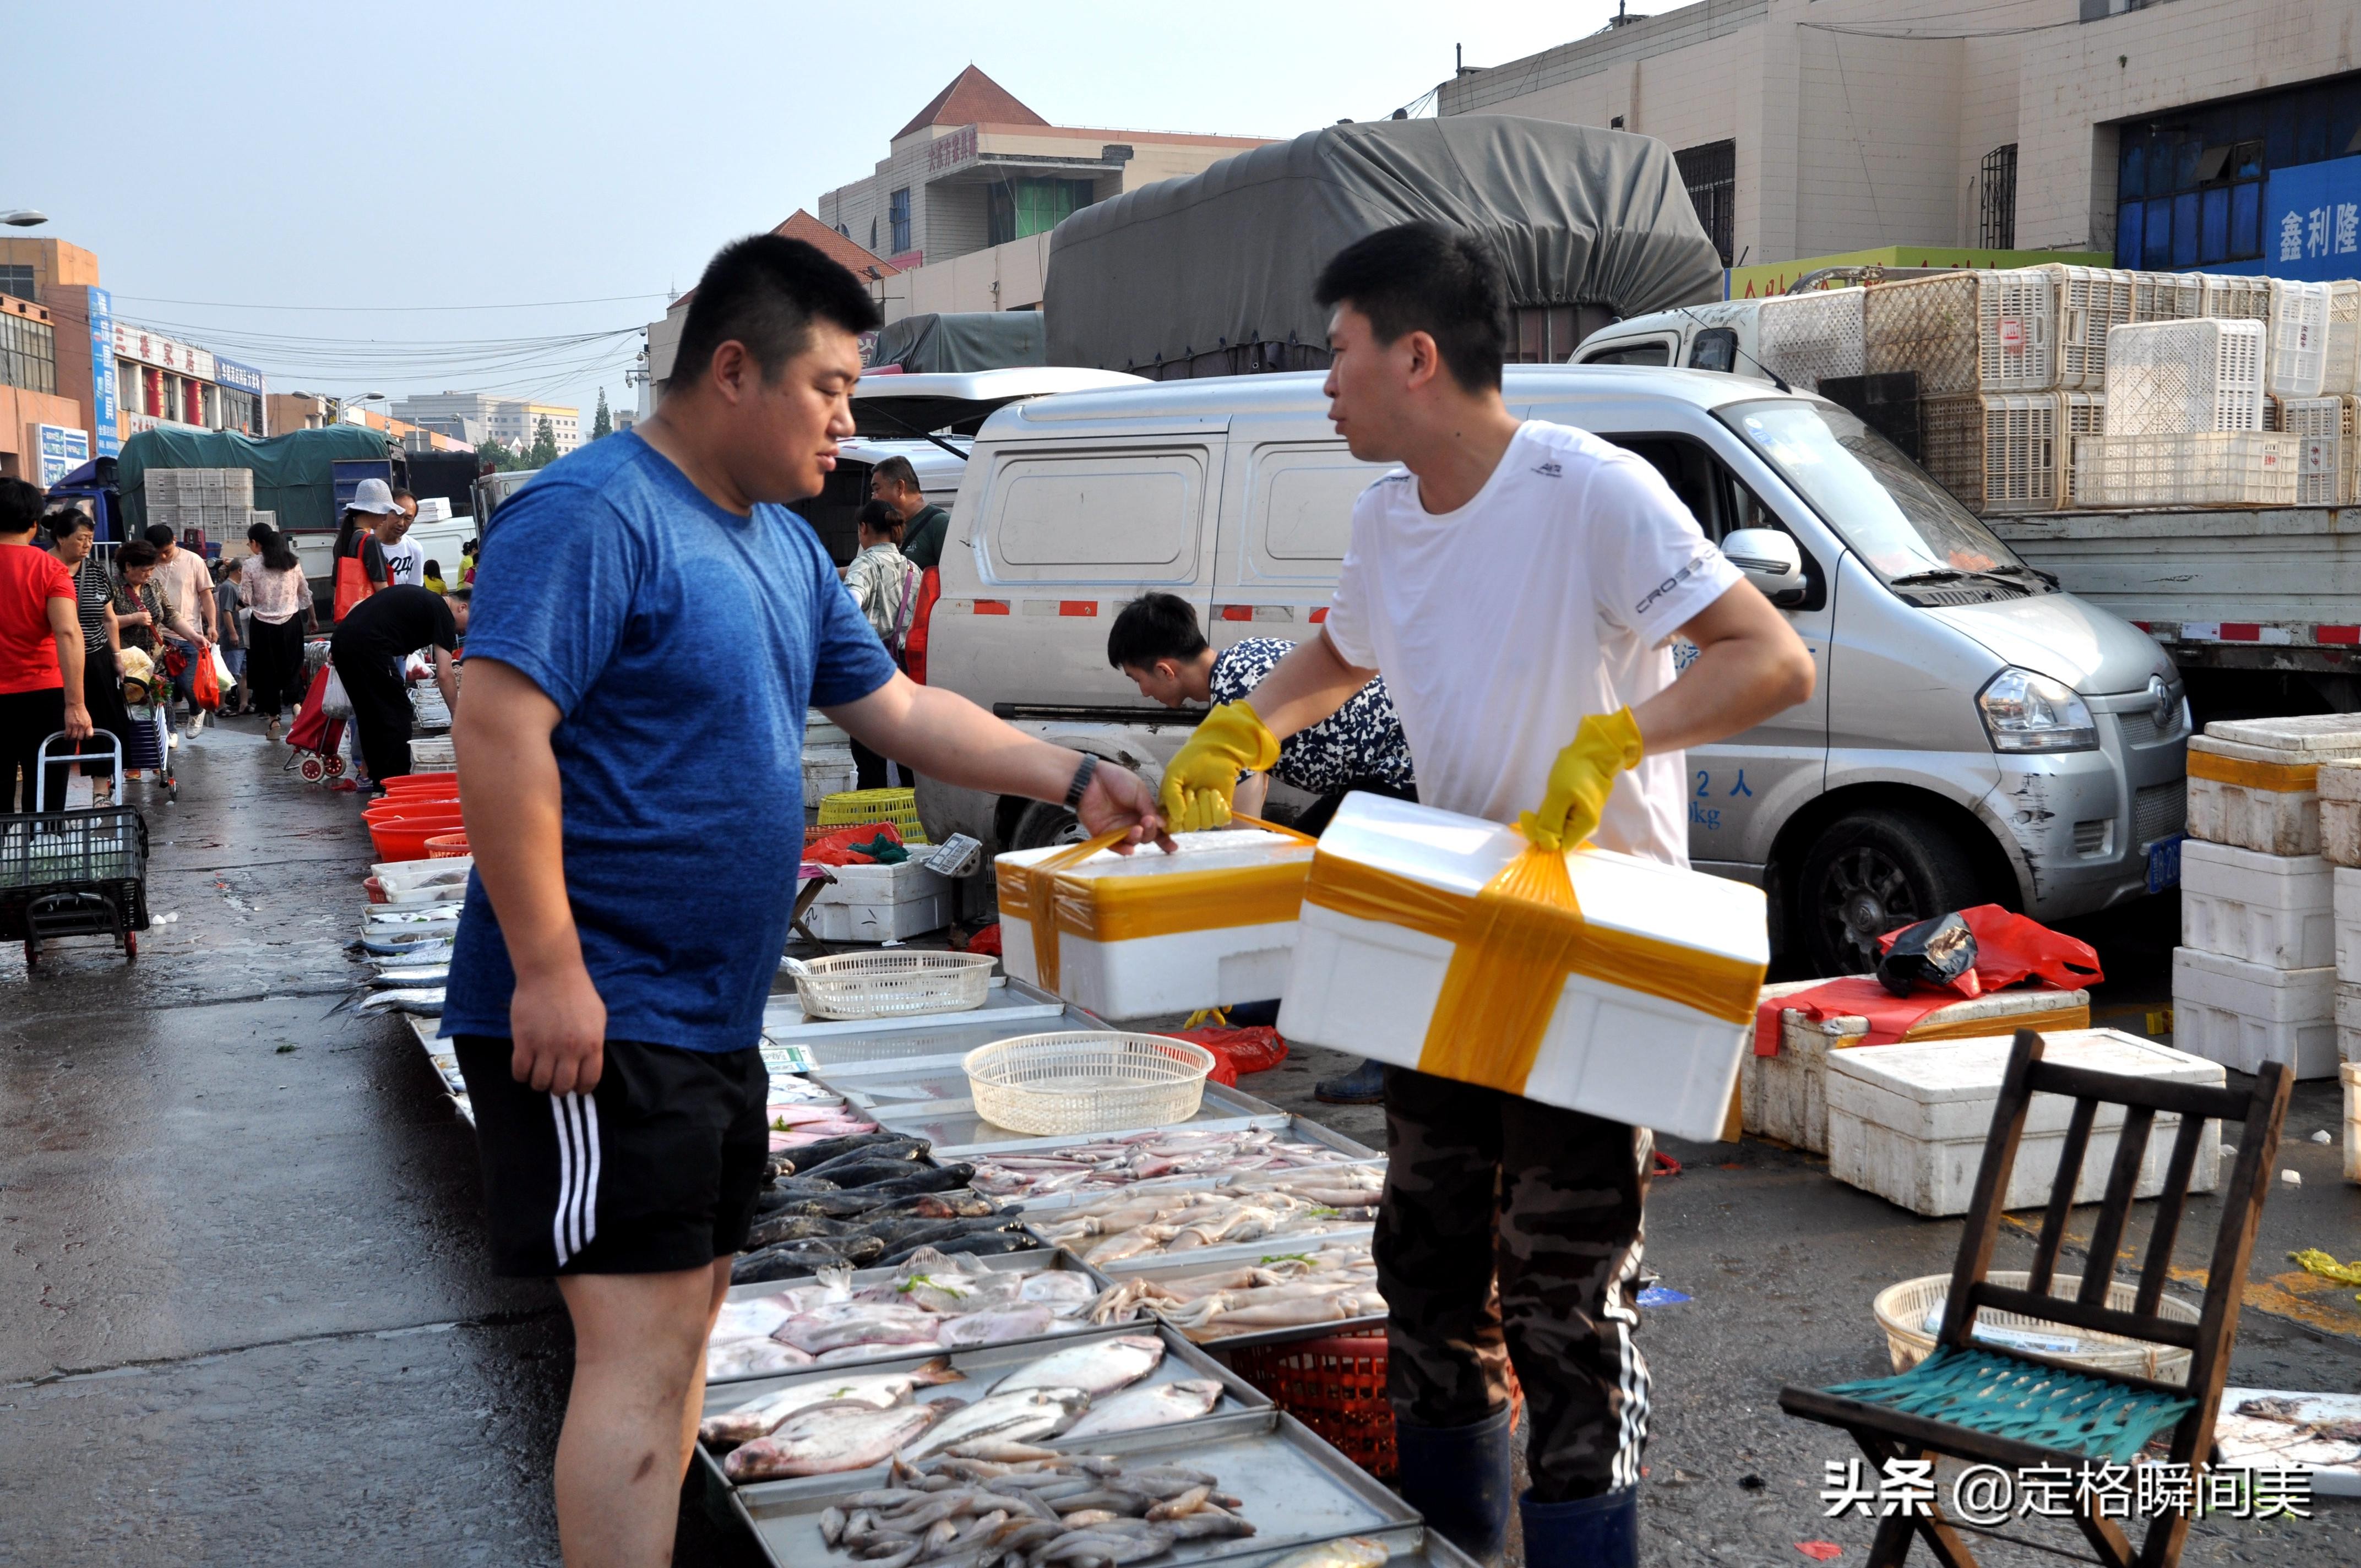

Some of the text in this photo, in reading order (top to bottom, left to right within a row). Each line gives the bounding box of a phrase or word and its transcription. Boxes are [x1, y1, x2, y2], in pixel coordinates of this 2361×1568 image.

[2280, 202, 2359, 262] 鑫利隆
[1636, 556, 1703, 613] CROSS
